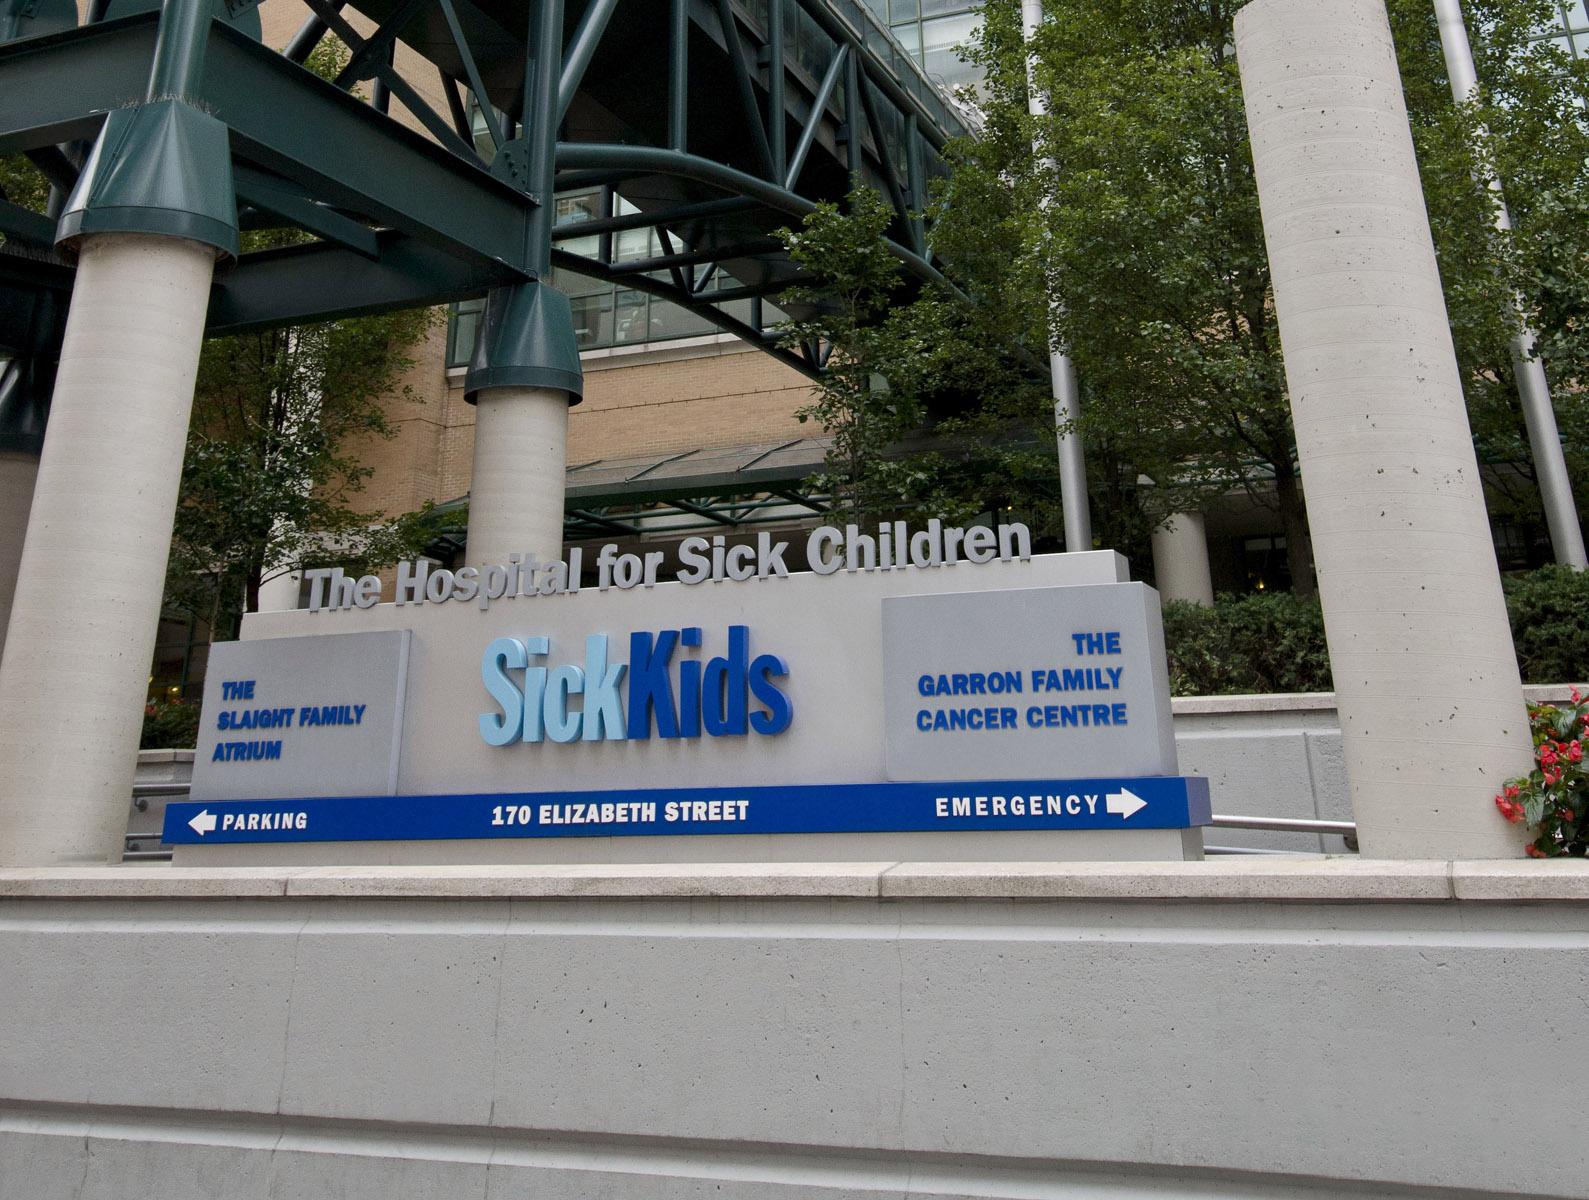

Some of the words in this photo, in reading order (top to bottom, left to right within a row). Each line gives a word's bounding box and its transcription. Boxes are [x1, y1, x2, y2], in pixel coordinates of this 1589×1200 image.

[304, 566, 382, 613] The
[395, 547, 583, 611] Hospital
[597, 543, 664, 591] for
[676, 531, 790, 585] Sick
[806, 518, 1032, 575] Children
[1072, 632, 1122, 656] THE
[221, 680, 256, 701] THE
[478, 625, 793, 747] SickKids
[918, 670, 1023, 697] GARRON
[1031, 666, 1124, 693] FAMILY
[217, 708, 295, 732] SLAIGHT
[299, 704, 367, 727] FAMILY
[916, 706, 1019, 732] CANCER
[1026, 703, 1129, 729] CENTRE
[212, 740, 282, 763] ATRIUM
[491, 805, 532, 826] 170
[538, 802, 657, 825] ELIZABETH
[664, 800, 750, 822] STREET
[935, 794, 1100, 818] EMERGENCY
[221, 812, 308, 832] PARKING
